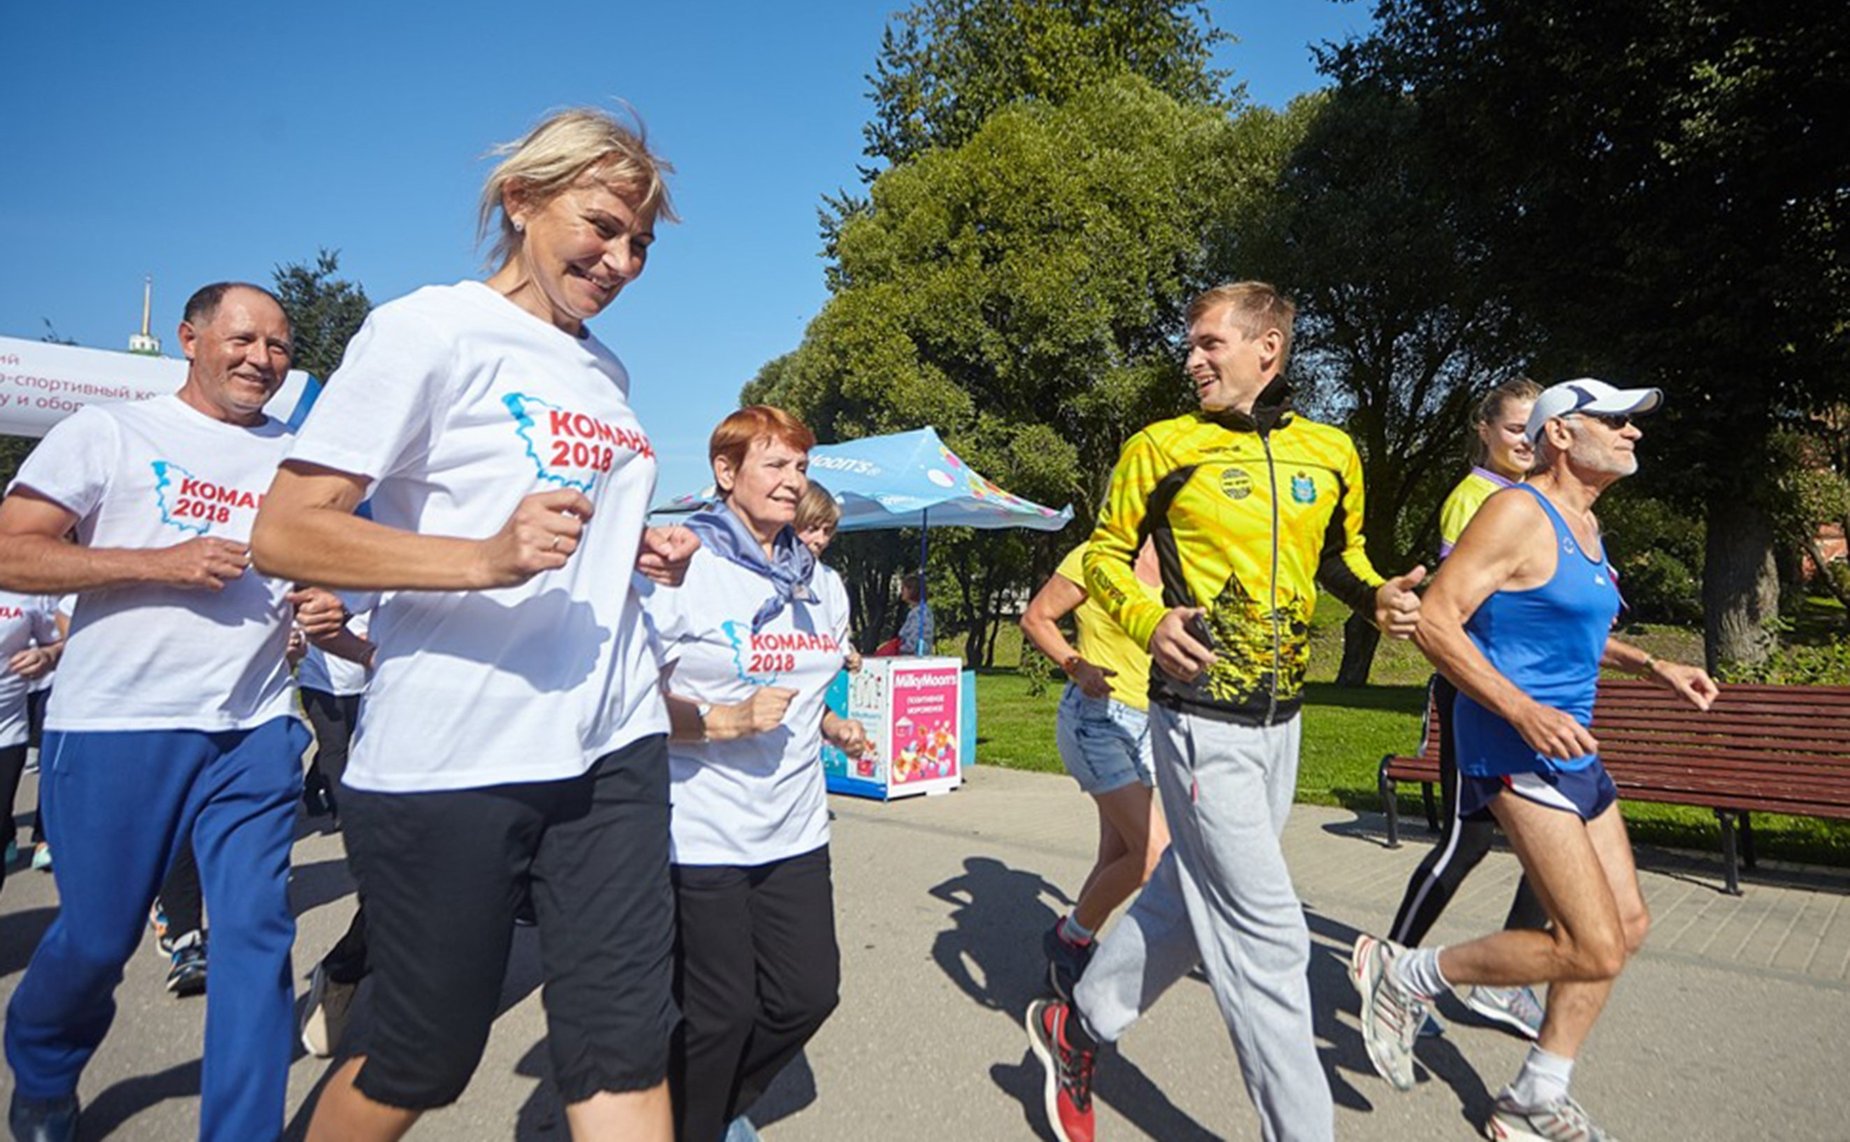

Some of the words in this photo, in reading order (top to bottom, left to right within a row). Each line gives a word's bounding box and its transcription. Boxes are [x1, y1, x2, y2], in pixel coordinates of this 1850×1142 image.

[17, 395, 29, 406] и
[550, 440, 613, 473] 2018
[172, 498, 230, 524] 2018
[747, 654, 795, 672] 2018
